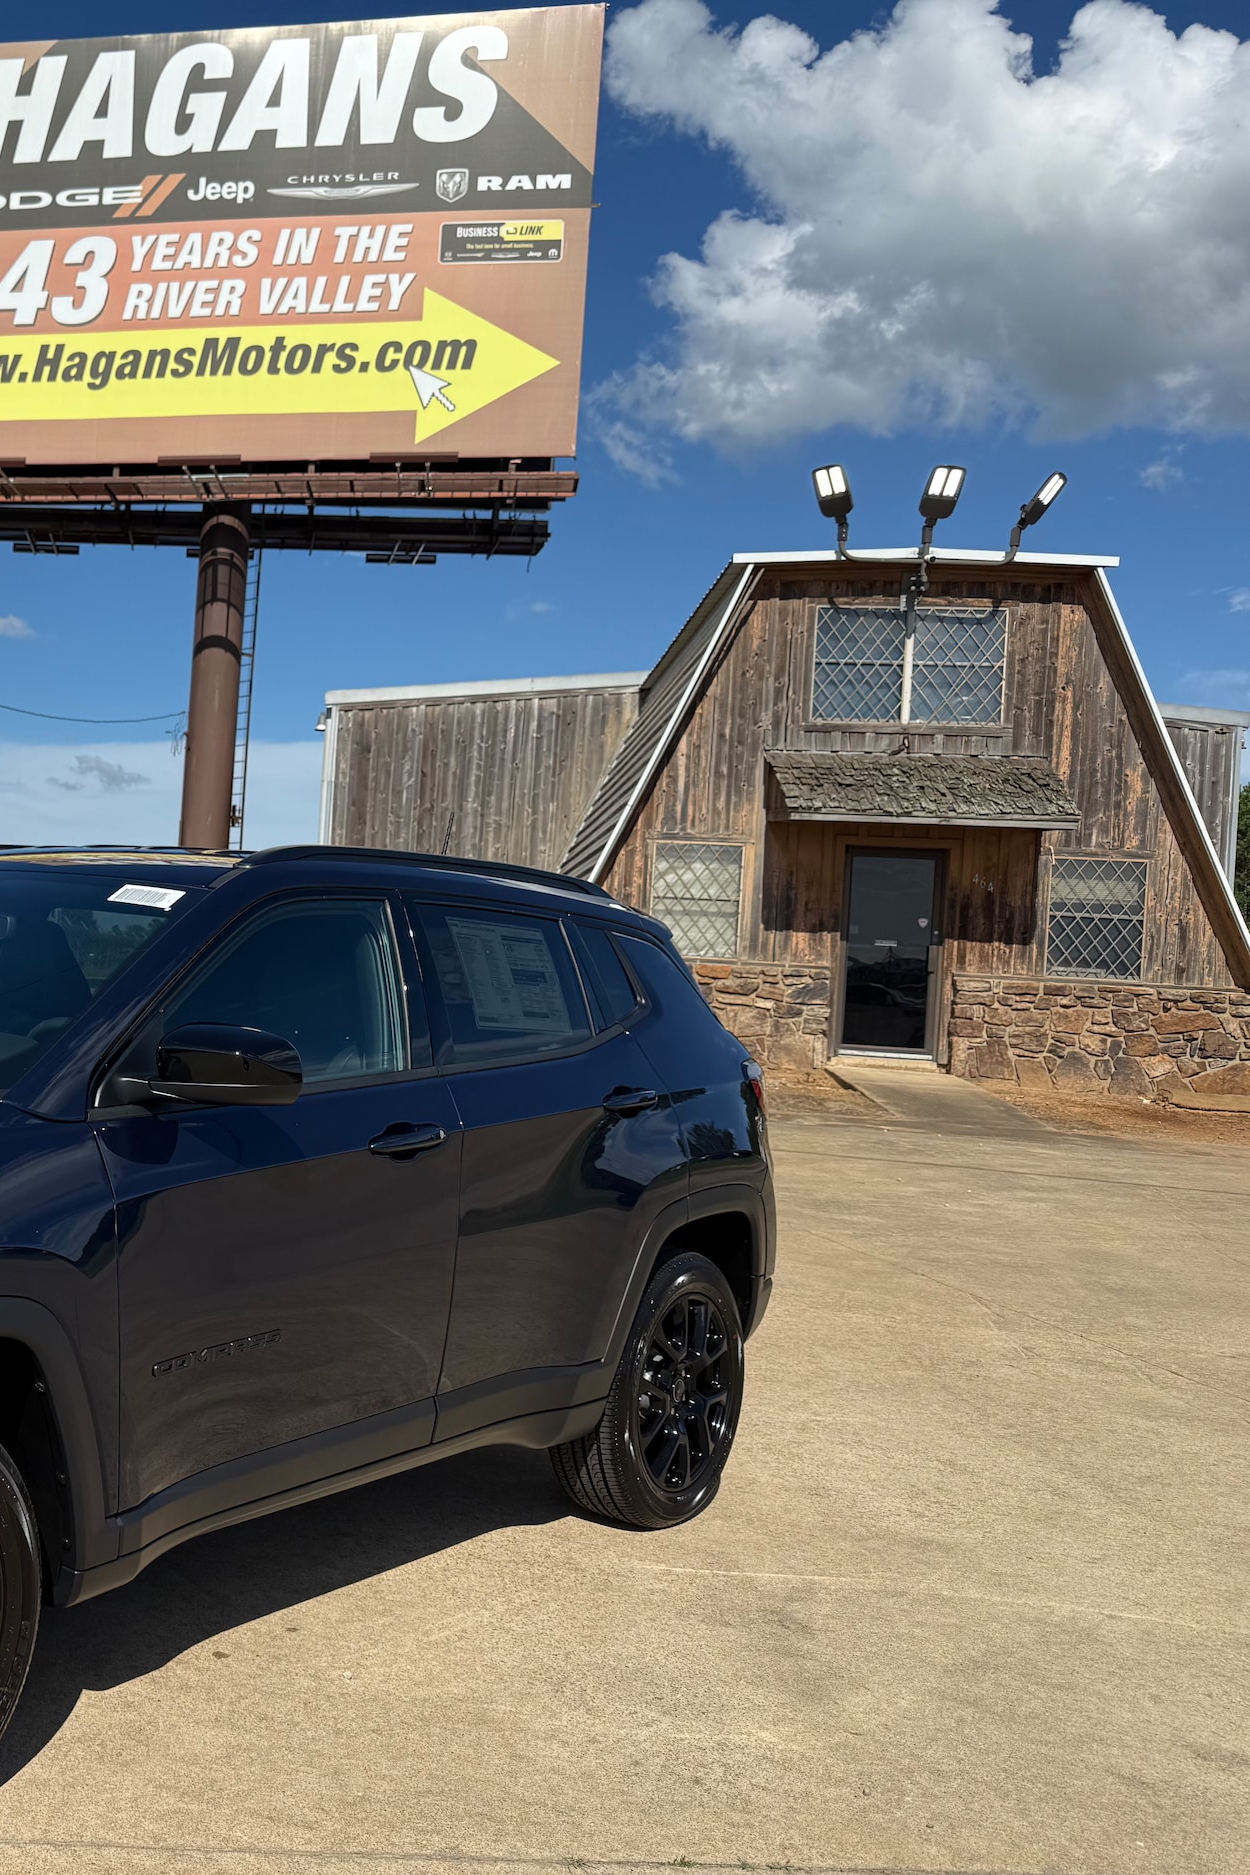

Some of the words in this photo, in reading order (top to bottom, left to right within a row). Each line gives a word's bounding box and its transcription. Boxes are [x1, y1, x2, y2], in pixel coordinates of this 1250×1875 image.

[287, 172, 400, 185] CHRYSLER
[476, 173, 572, 191] RAM
[187, 177, 255, 204] Jeep
[519, 225, 544, 236] LINK
[130, 228, 261, 272] YEARS
[272, 227, 321, 266] IN
[332, 223, 413, 263] THE
[122, 278, 247, 321] RIVER
[259, 272, 417, 315] VALLEY
[972, 873, 994, 893] 464
